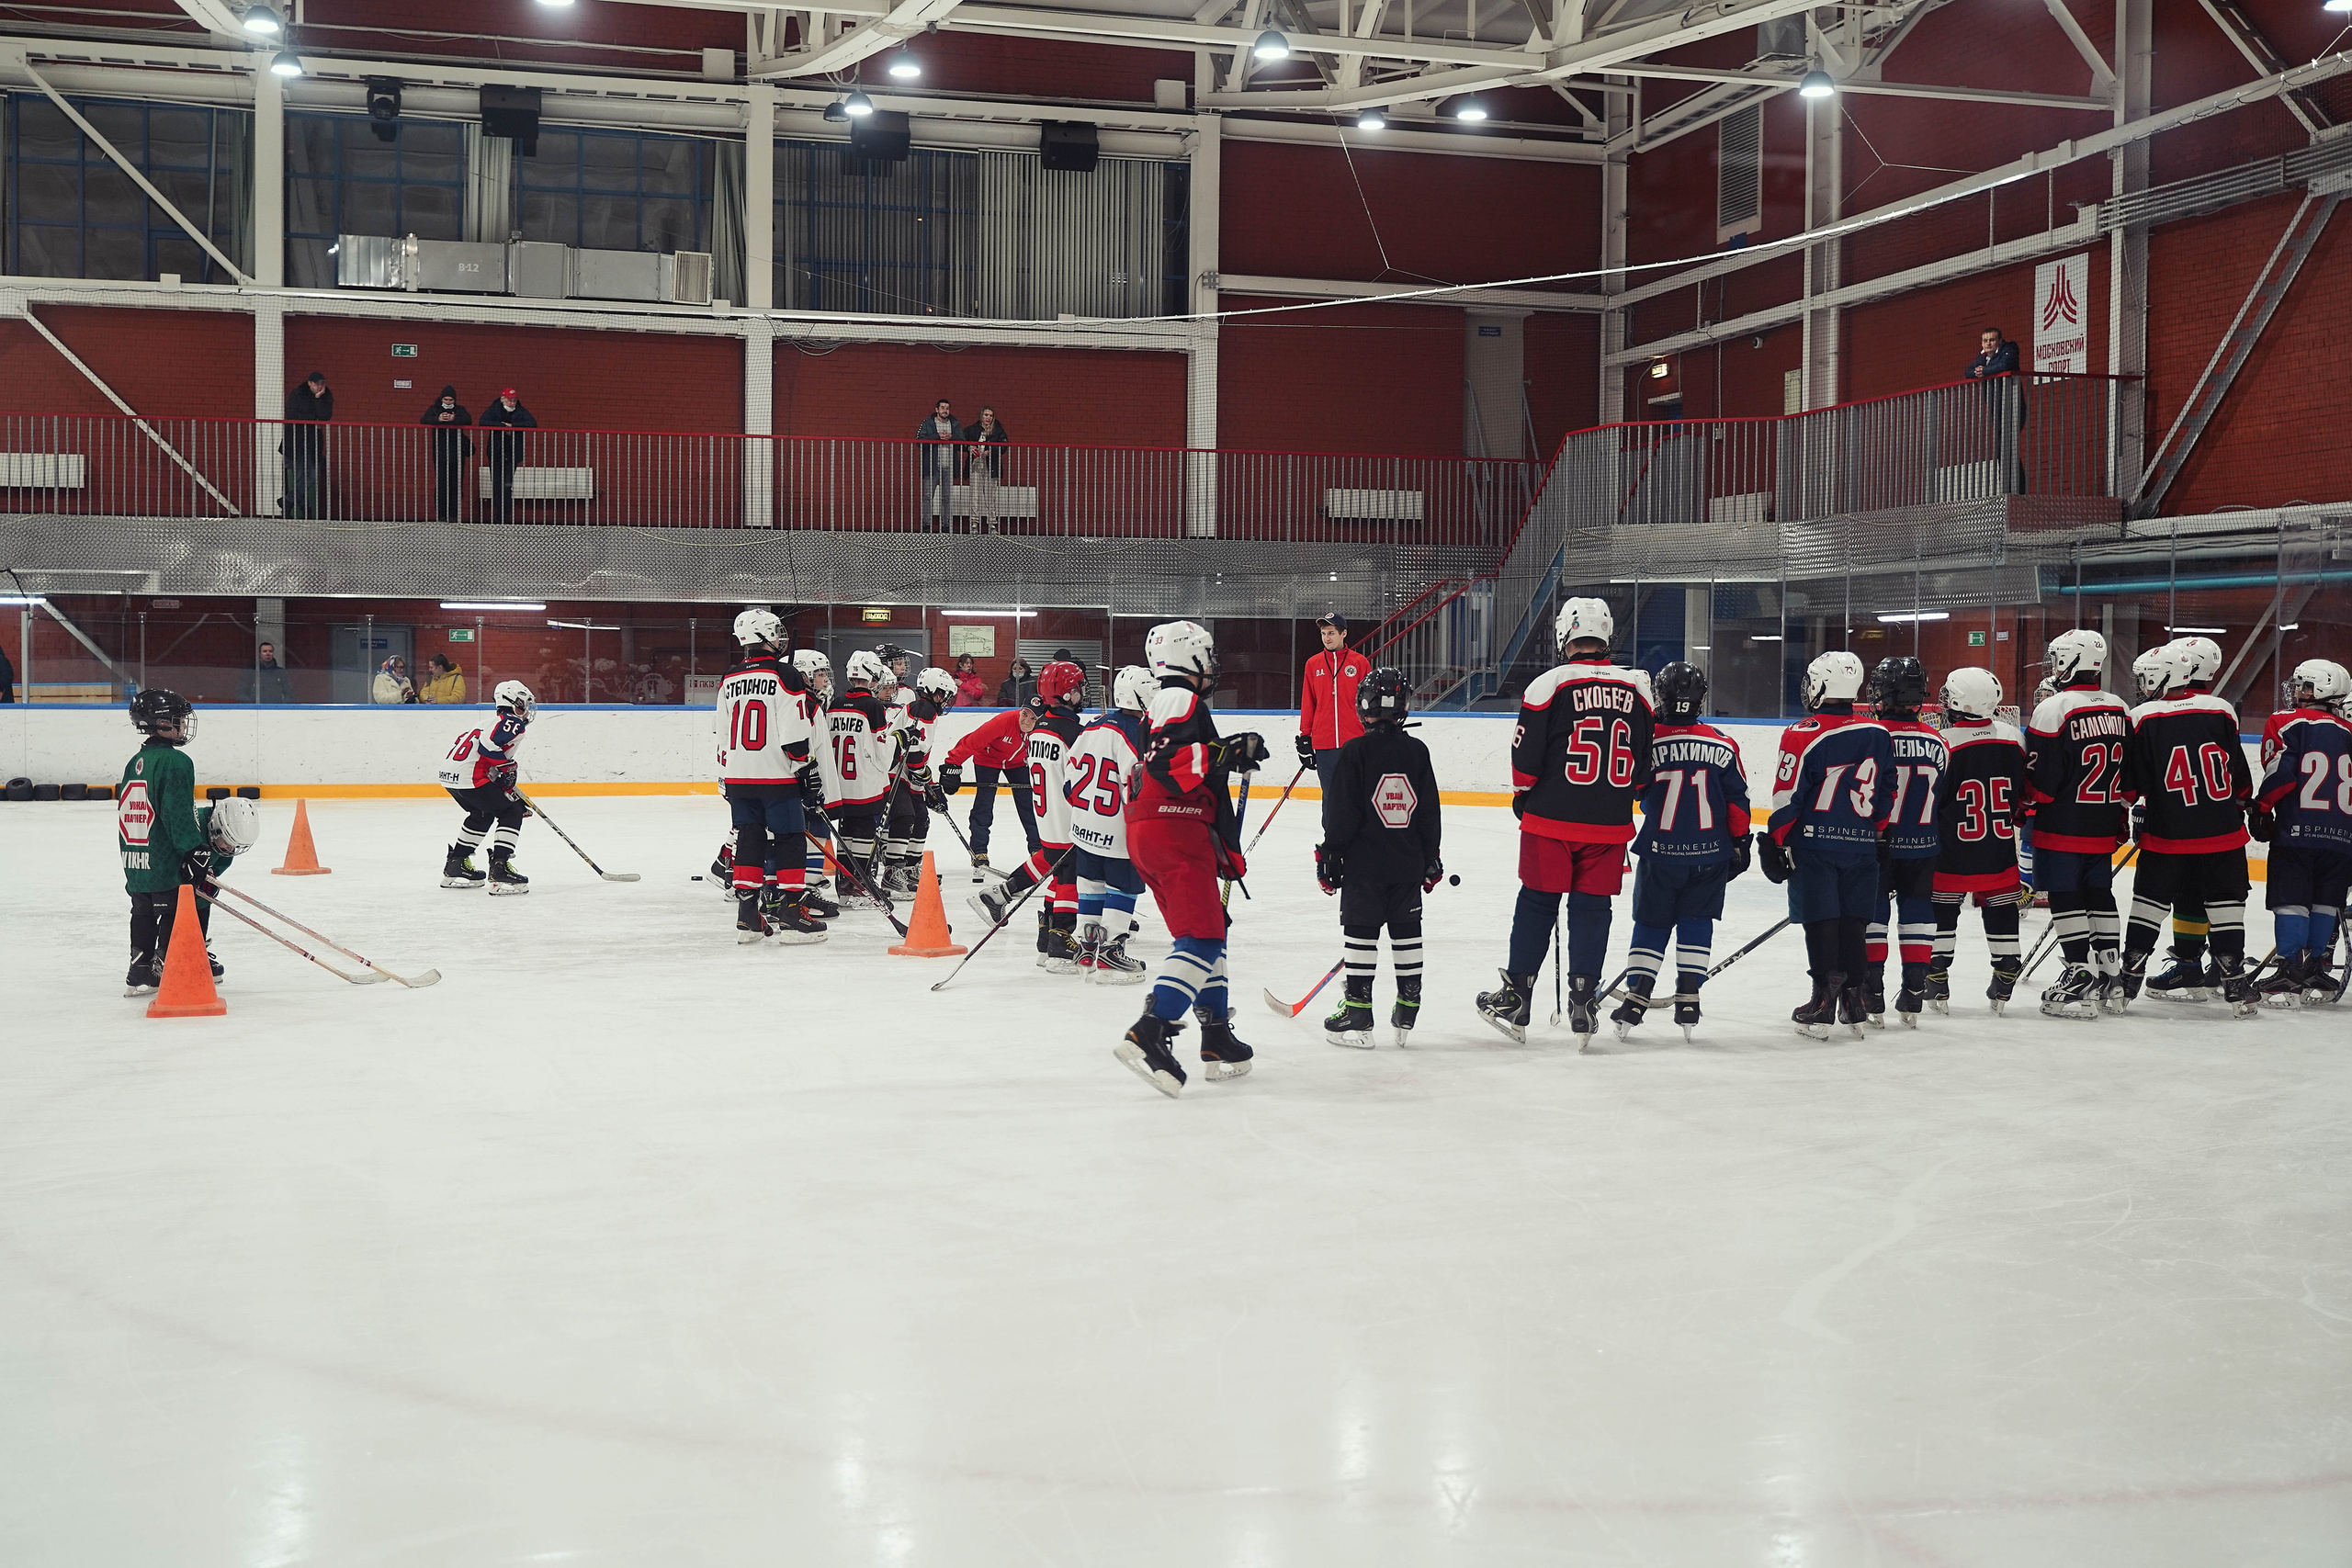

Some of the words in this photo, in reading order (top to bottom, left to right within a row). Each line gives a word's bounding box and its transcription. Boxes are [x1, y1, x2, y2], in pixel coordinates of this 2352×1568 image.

[2036, 333, 2085, 361] МОСКОВСКИЙ
[865, 612, 888, 621] ВЫХОД
[1572, 685, 1634, 714] СКОБЕЕВ
[1675, 701, 1690, 713] 19
[729, 699, 767, 751] 10
[832, 735, 857, 780] 16
[1565, 716, 1635, 788] 56
[2165, 741, 2233, 807] 40
[1070, 752, 1123, 817] 25
[1655, 768, 1713, 832] 71
[1956, 776, 2014, 842] 35
[1660, 840, 1719, 851] SPINETIX
